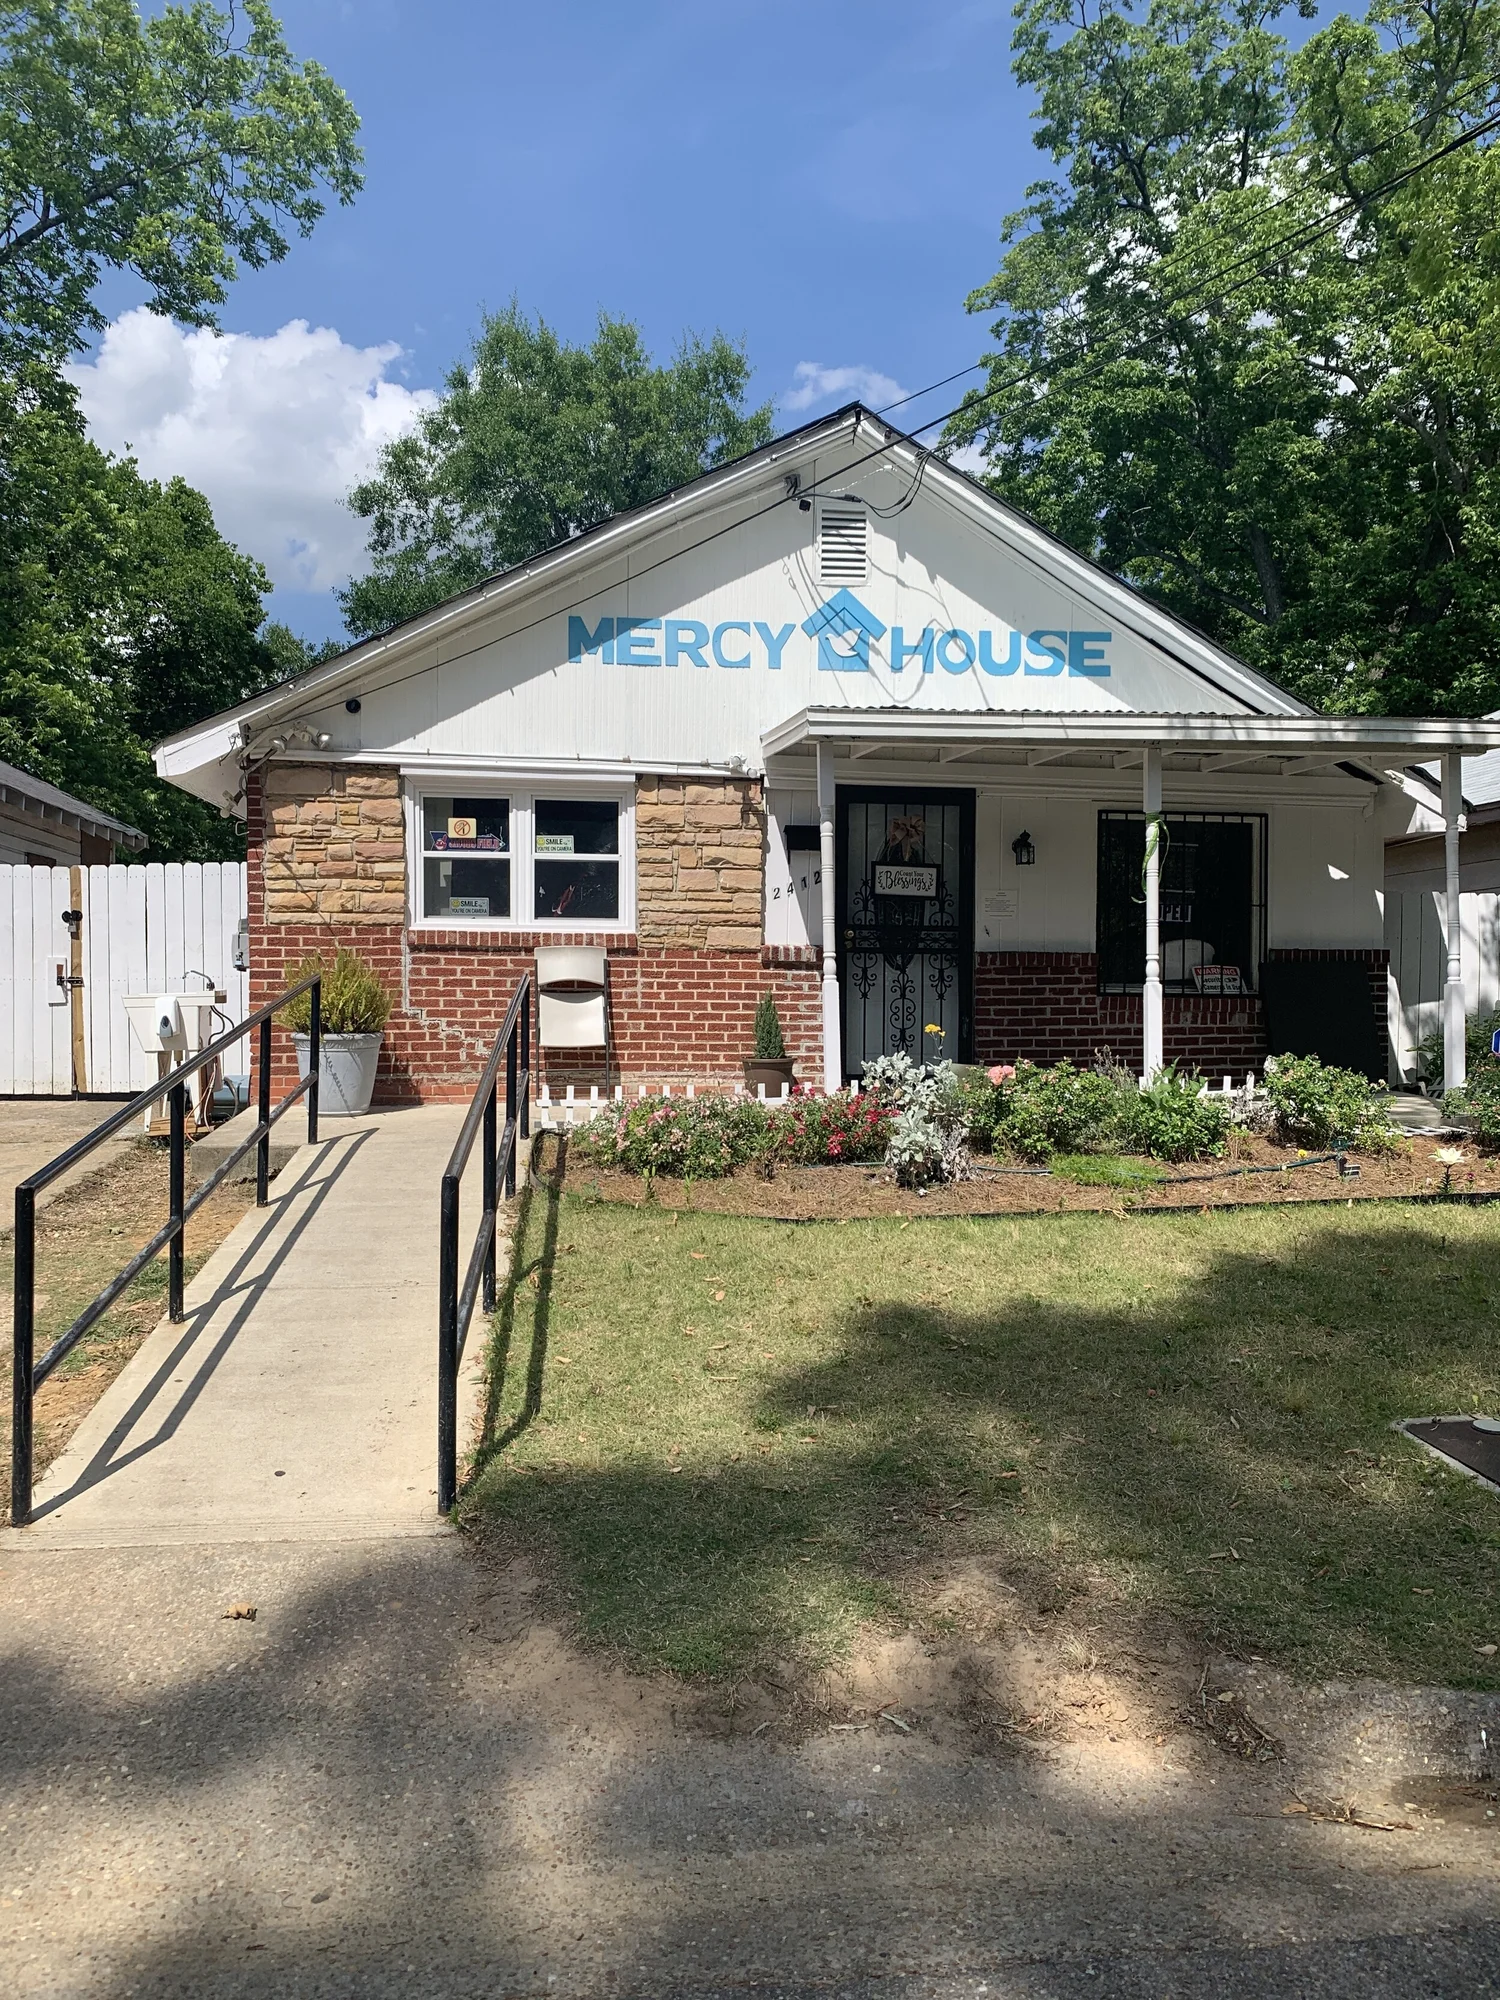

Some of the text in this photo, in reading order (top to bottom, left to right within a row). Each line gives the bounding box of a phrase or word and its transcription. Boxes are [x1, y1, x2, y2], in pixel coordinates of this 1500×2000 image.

[568, 615, 1113, 677] MERCY HOUSE
[884, 870, 926, 892] Blessings
[460, 900, 478, 908] SMILE
[1196, 967, 1237, 976] WARNING
